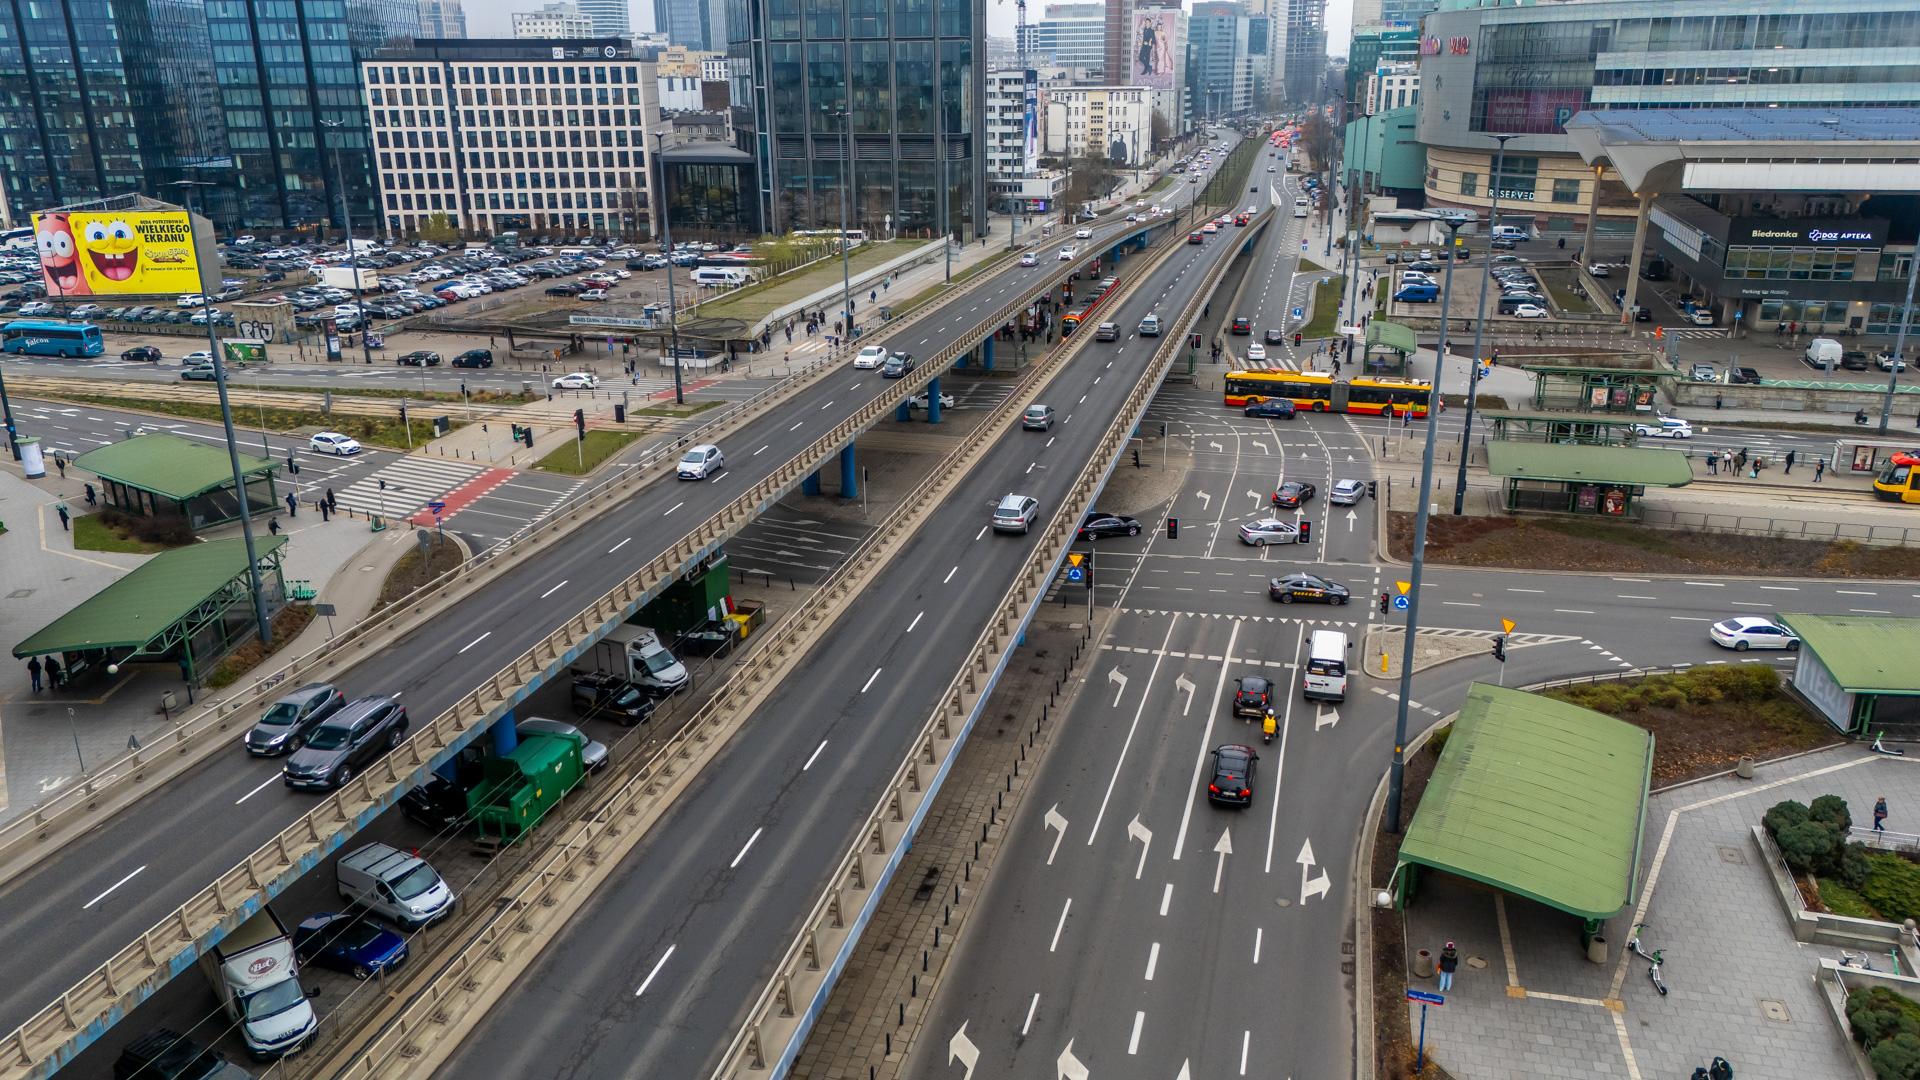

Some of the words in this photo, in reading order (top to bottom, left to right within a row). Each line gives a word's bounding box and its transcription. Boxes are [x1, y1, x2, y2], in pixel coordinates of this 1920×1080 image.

[135, 224, 190, 233] WIELKIEGO
[144, 234, 185, 242] EKRANU
[1752, 230, 1798, 238] Biedronka
[25, 337, 49, 347] Falcon
